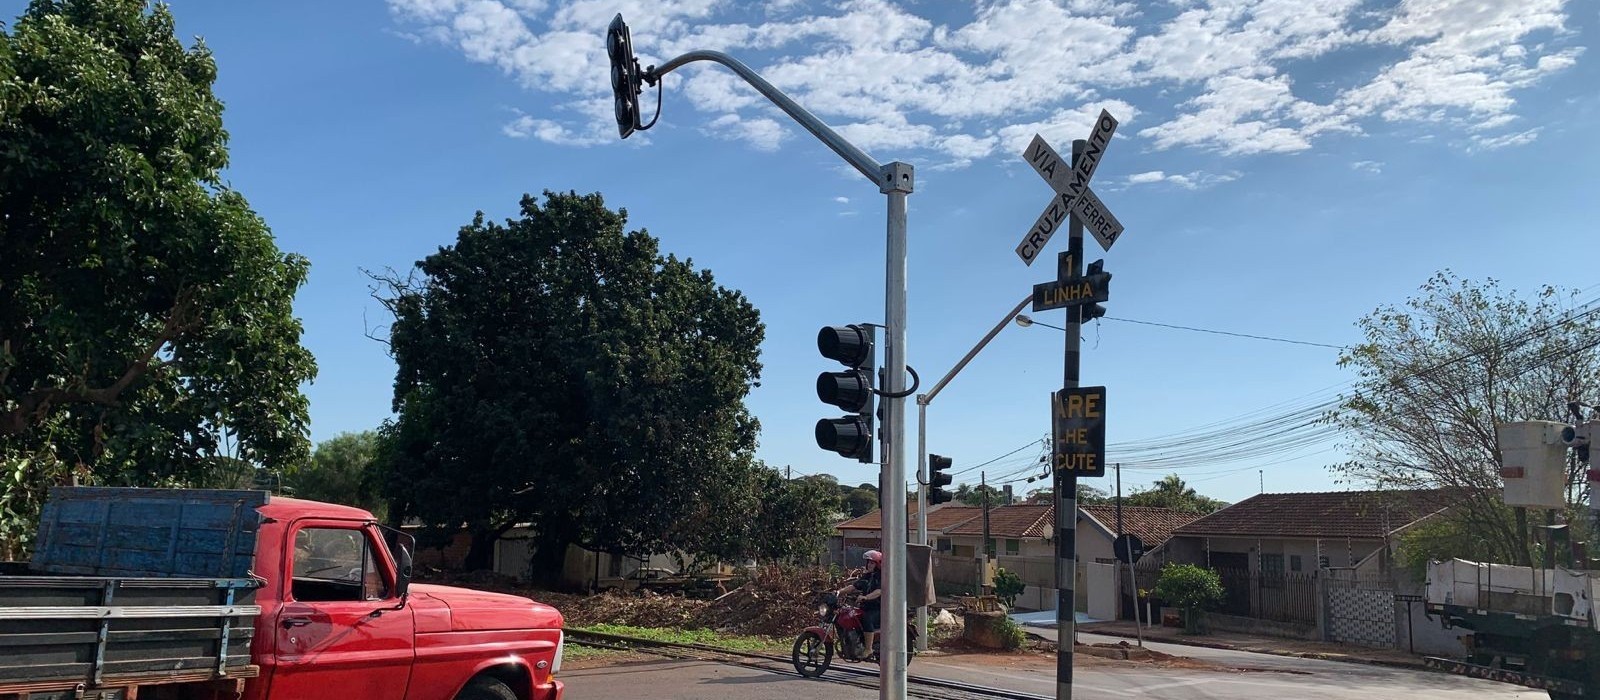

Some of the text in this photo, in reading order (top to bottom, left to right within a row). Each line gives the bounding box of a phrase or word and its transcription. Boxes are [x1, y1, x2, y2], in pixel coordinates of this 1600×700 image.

[1031, 144, 1057, 180] VIA
[1021, 116, 1113, 260] CRUZAMENTO
[1065, 254, 1073, 276] 1
[1044, 281, 1093, 305] LINHA
